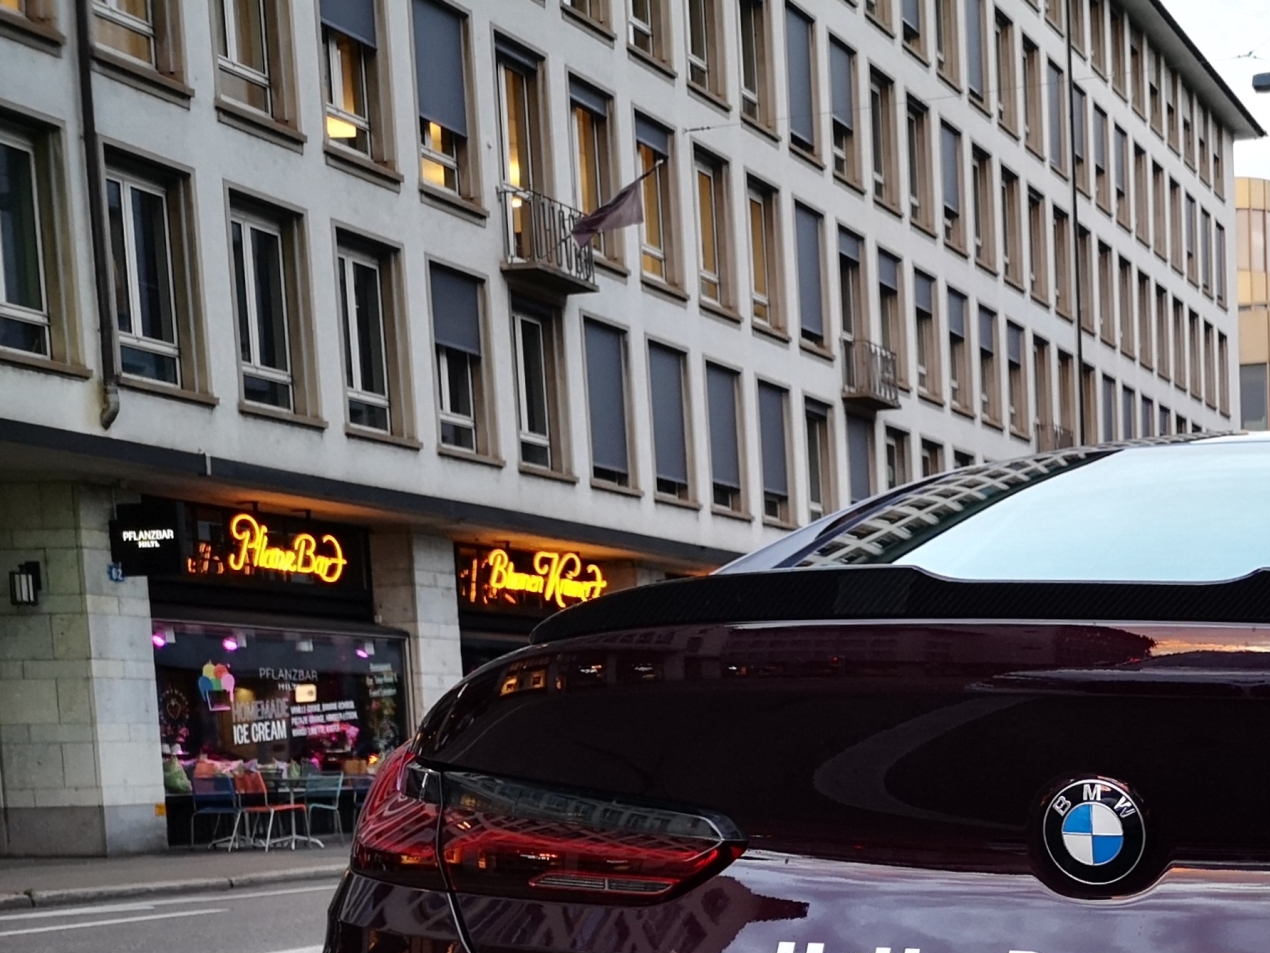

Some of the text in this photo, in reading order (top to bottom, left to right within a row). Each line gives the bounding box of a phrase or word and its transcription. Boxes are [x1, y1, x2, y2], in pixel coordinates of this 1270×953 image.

[122, 529, 174, 542] PFLANZBAR
[259, 666, 319, 682] PFLANZBAR
[231, 698, 290, 722] HOMEMADE
[232, 723, 251, 746] ICE
[251, 720, 288, 744] CREAM
[1052, 783, 1136, 818] BMW
